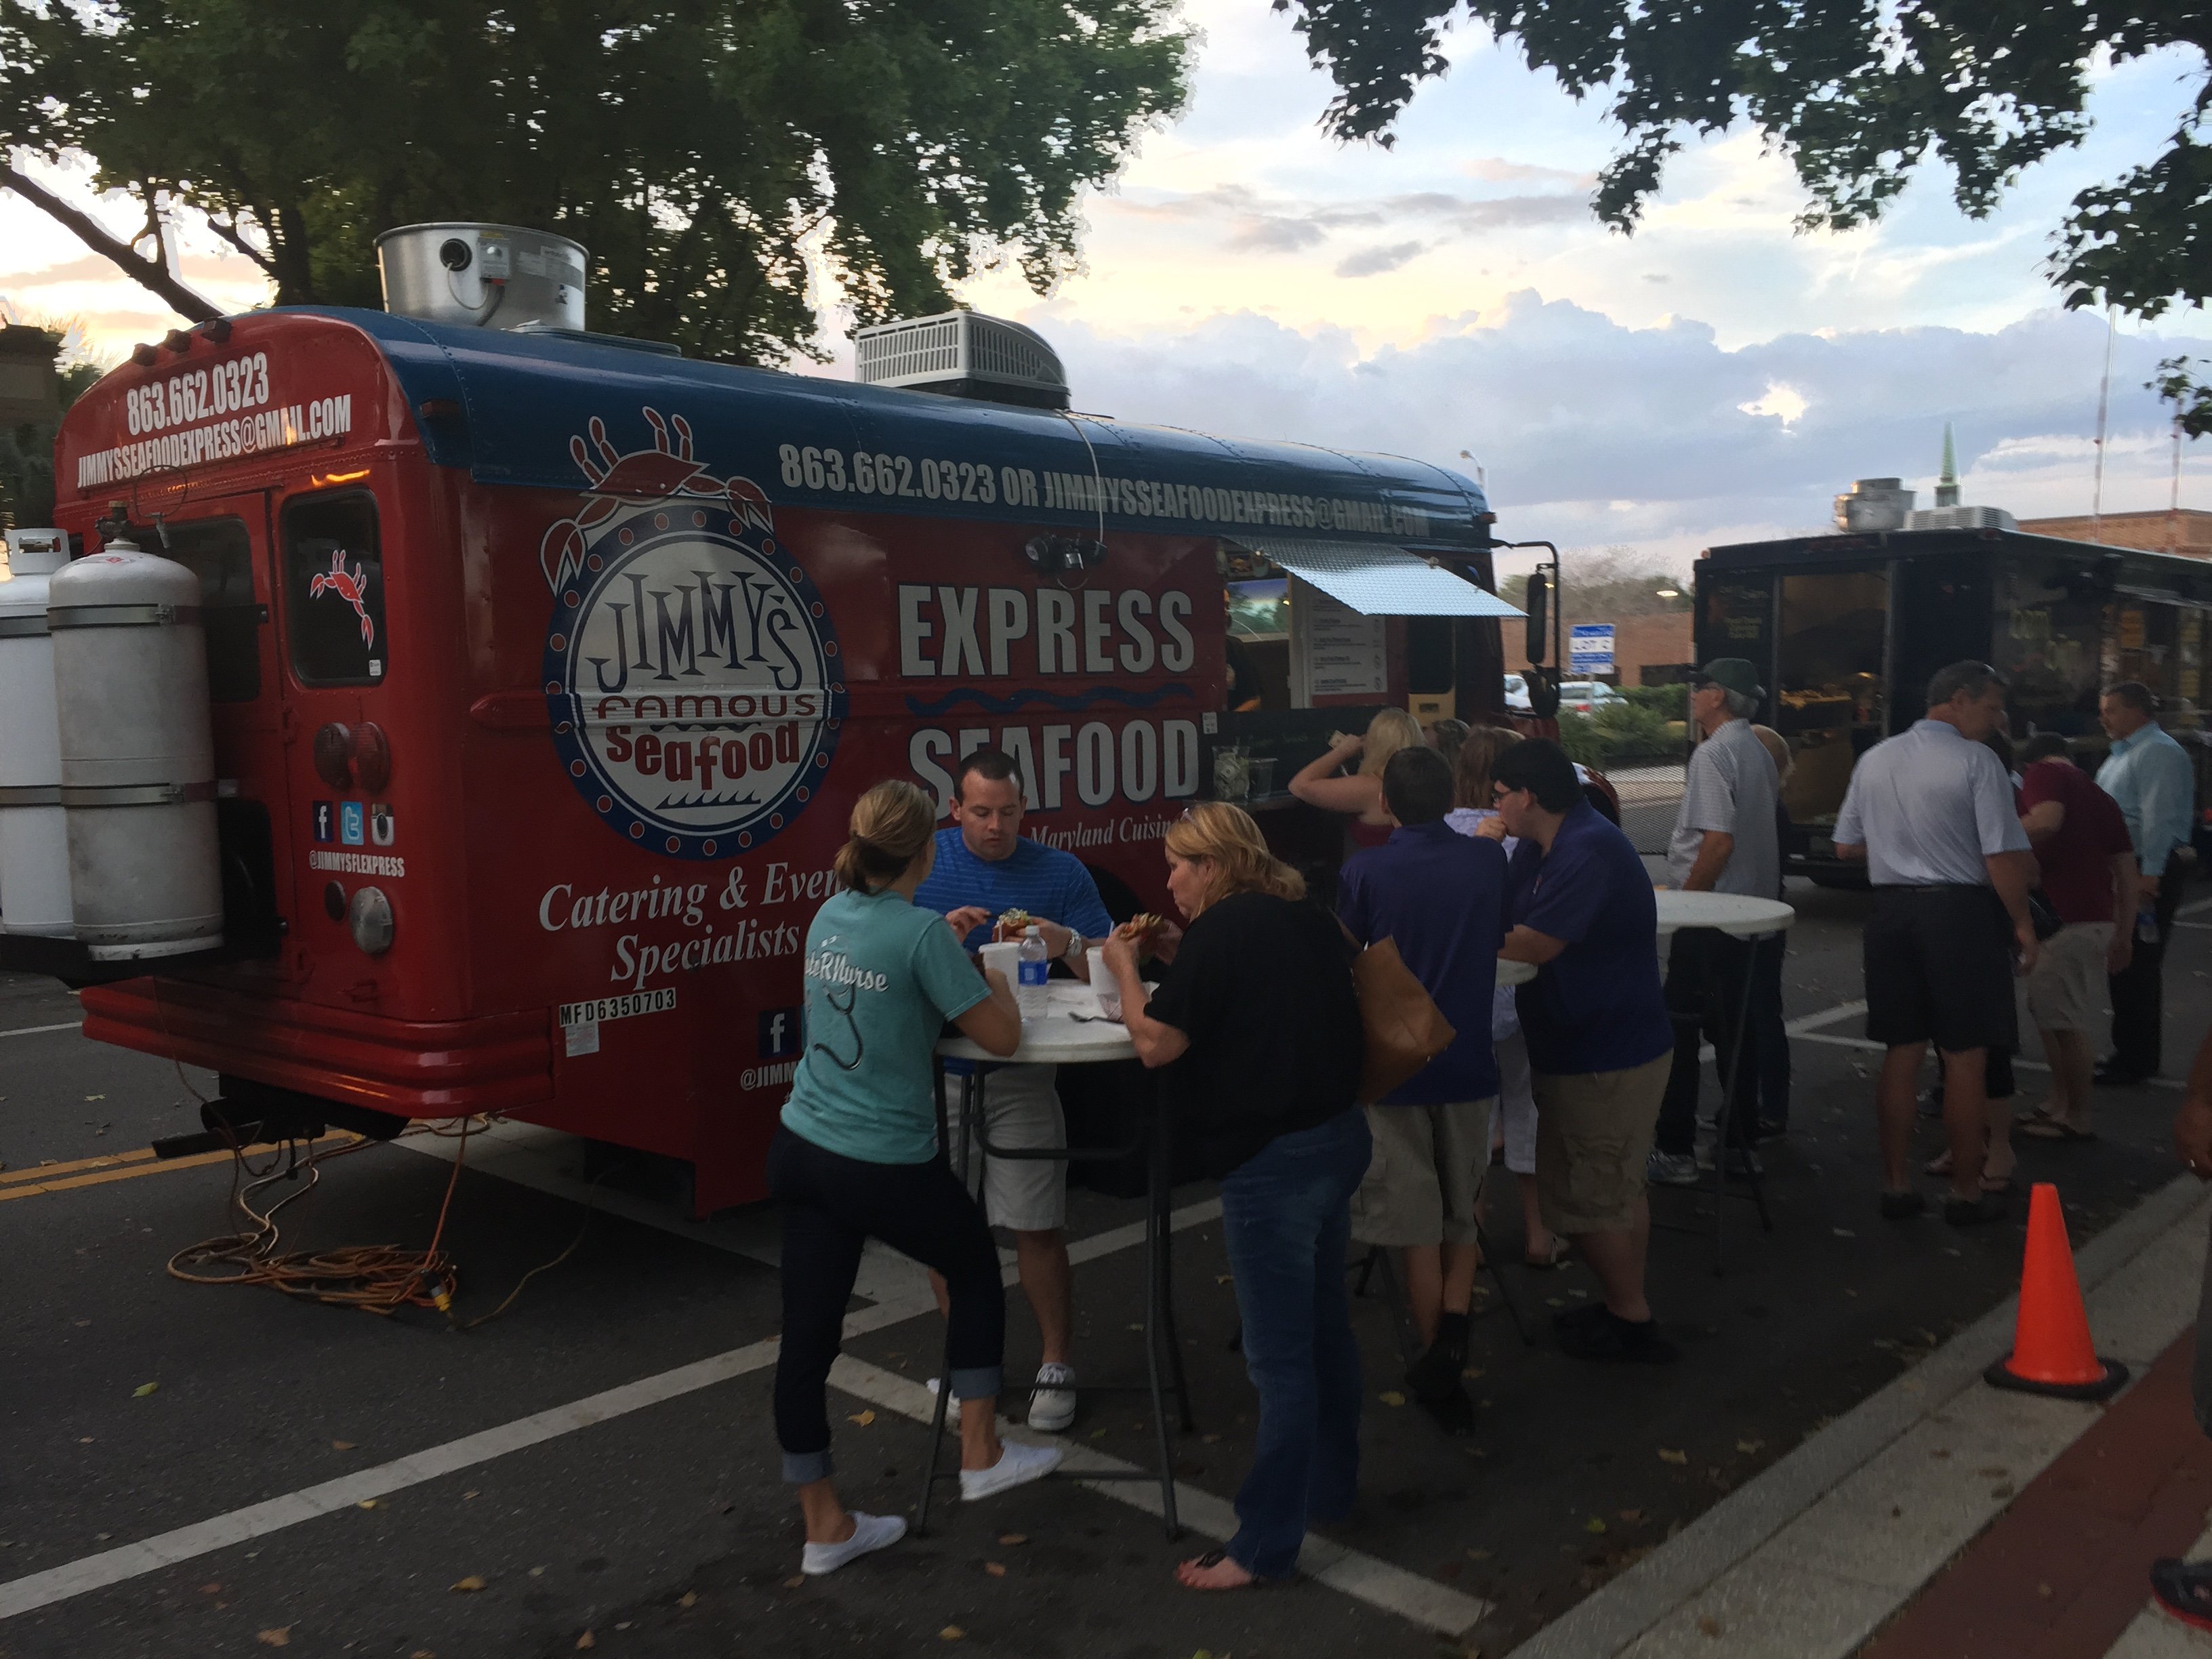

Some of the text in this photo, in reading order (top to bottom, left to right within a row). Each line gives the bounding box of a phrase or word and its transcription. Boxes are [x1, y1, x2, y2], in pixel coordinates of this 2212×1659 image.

[127, 352, 269, 436] 863.662.0323
[77, 394, 351, 488] JIMMYSSEAFOODEXPRESS@GMAIL.COM
[779, 443, 1431, 537] 863.662.0323 OR JIMMYSSEAFOODEXPRESS@GMAIL.COM
[585, 570, 800, 693] JIMMY'S
[898, 583, 1195, 676] EXPRESS
[909, 719, 1200, 821] SAFOOD
[309, 850, 405, 878] @JIMMYSFLEXPRESS
[1030, 814, 1172, 851] Maryland Cuisin
[539, 862, 845, 932] Catering & Even
[611, 918, 800, 991] Specialists
[560, 989, 675, 1026] MFD6350703
